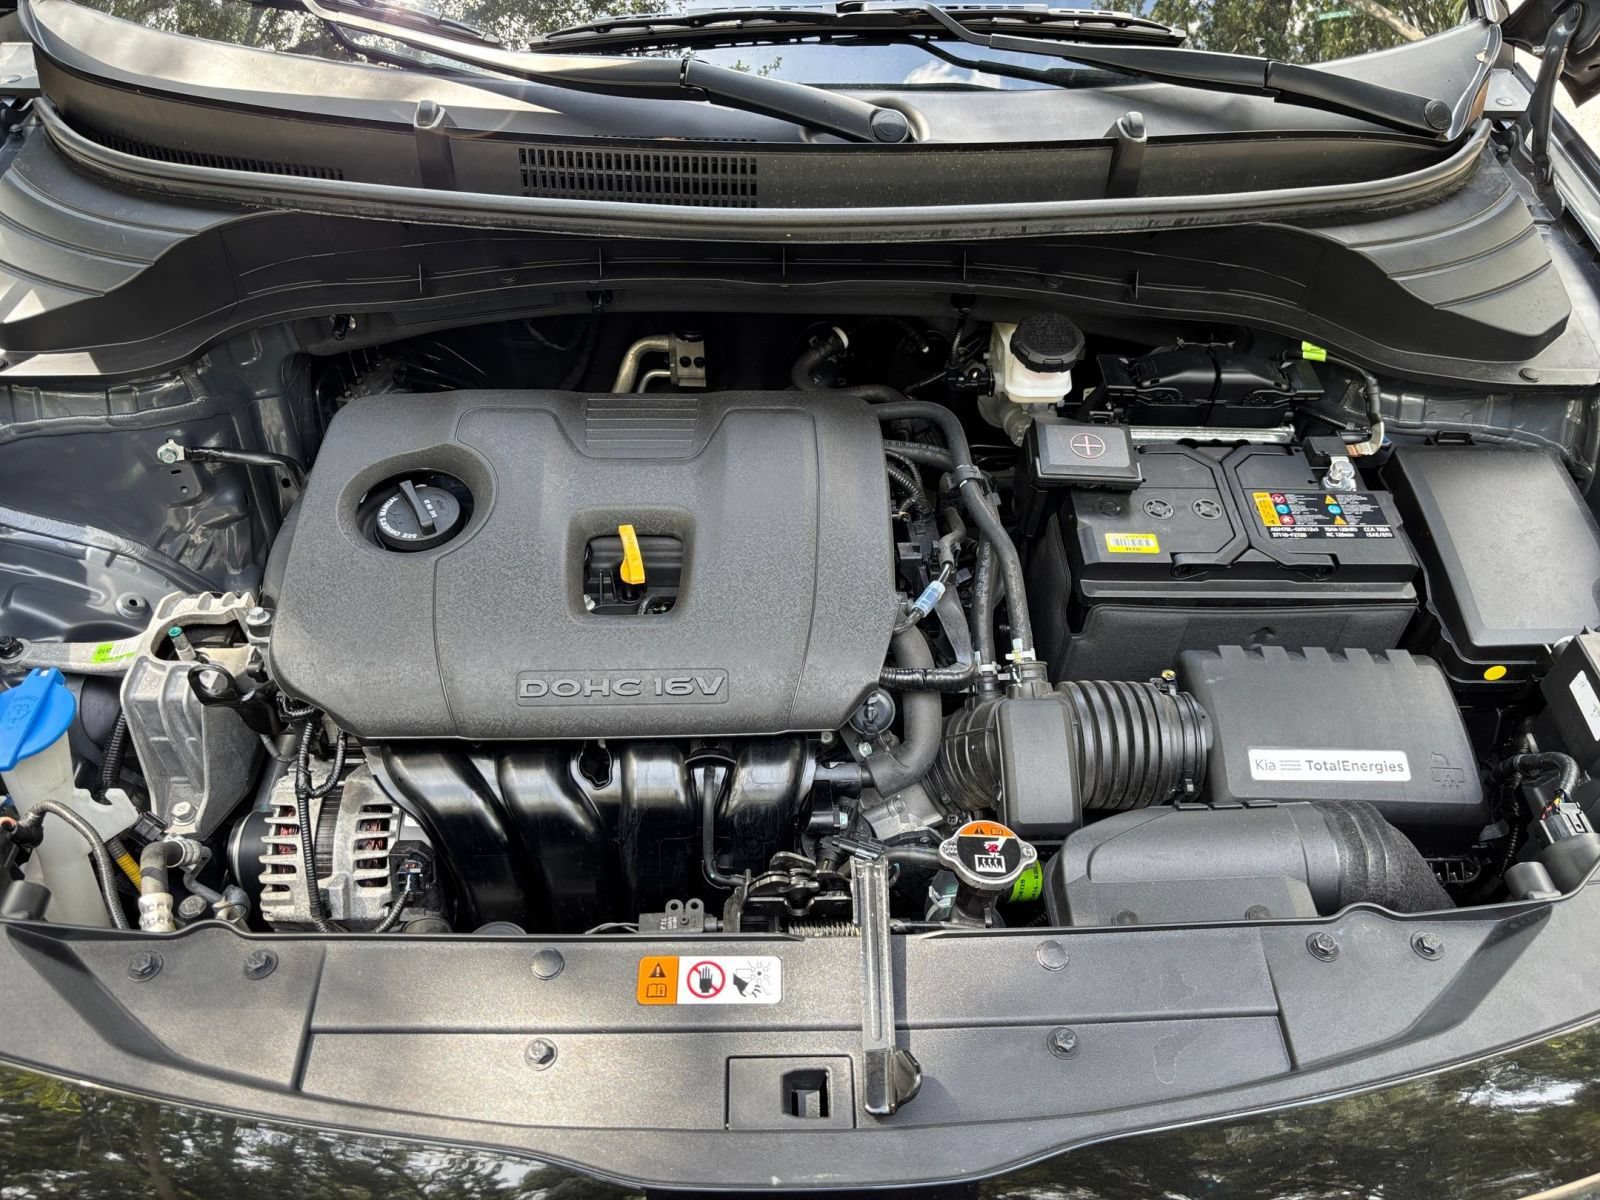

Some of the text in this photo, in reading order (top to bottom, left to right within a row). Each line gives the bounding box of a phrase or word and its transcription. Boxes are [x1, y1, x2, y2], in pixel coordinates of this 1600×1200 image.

[379, 496, 399, 517] MANUAL
[519, 676, 725, 698] DOHC 16V
[1255, 759, 1404, 774] Kia TotalEnergies
